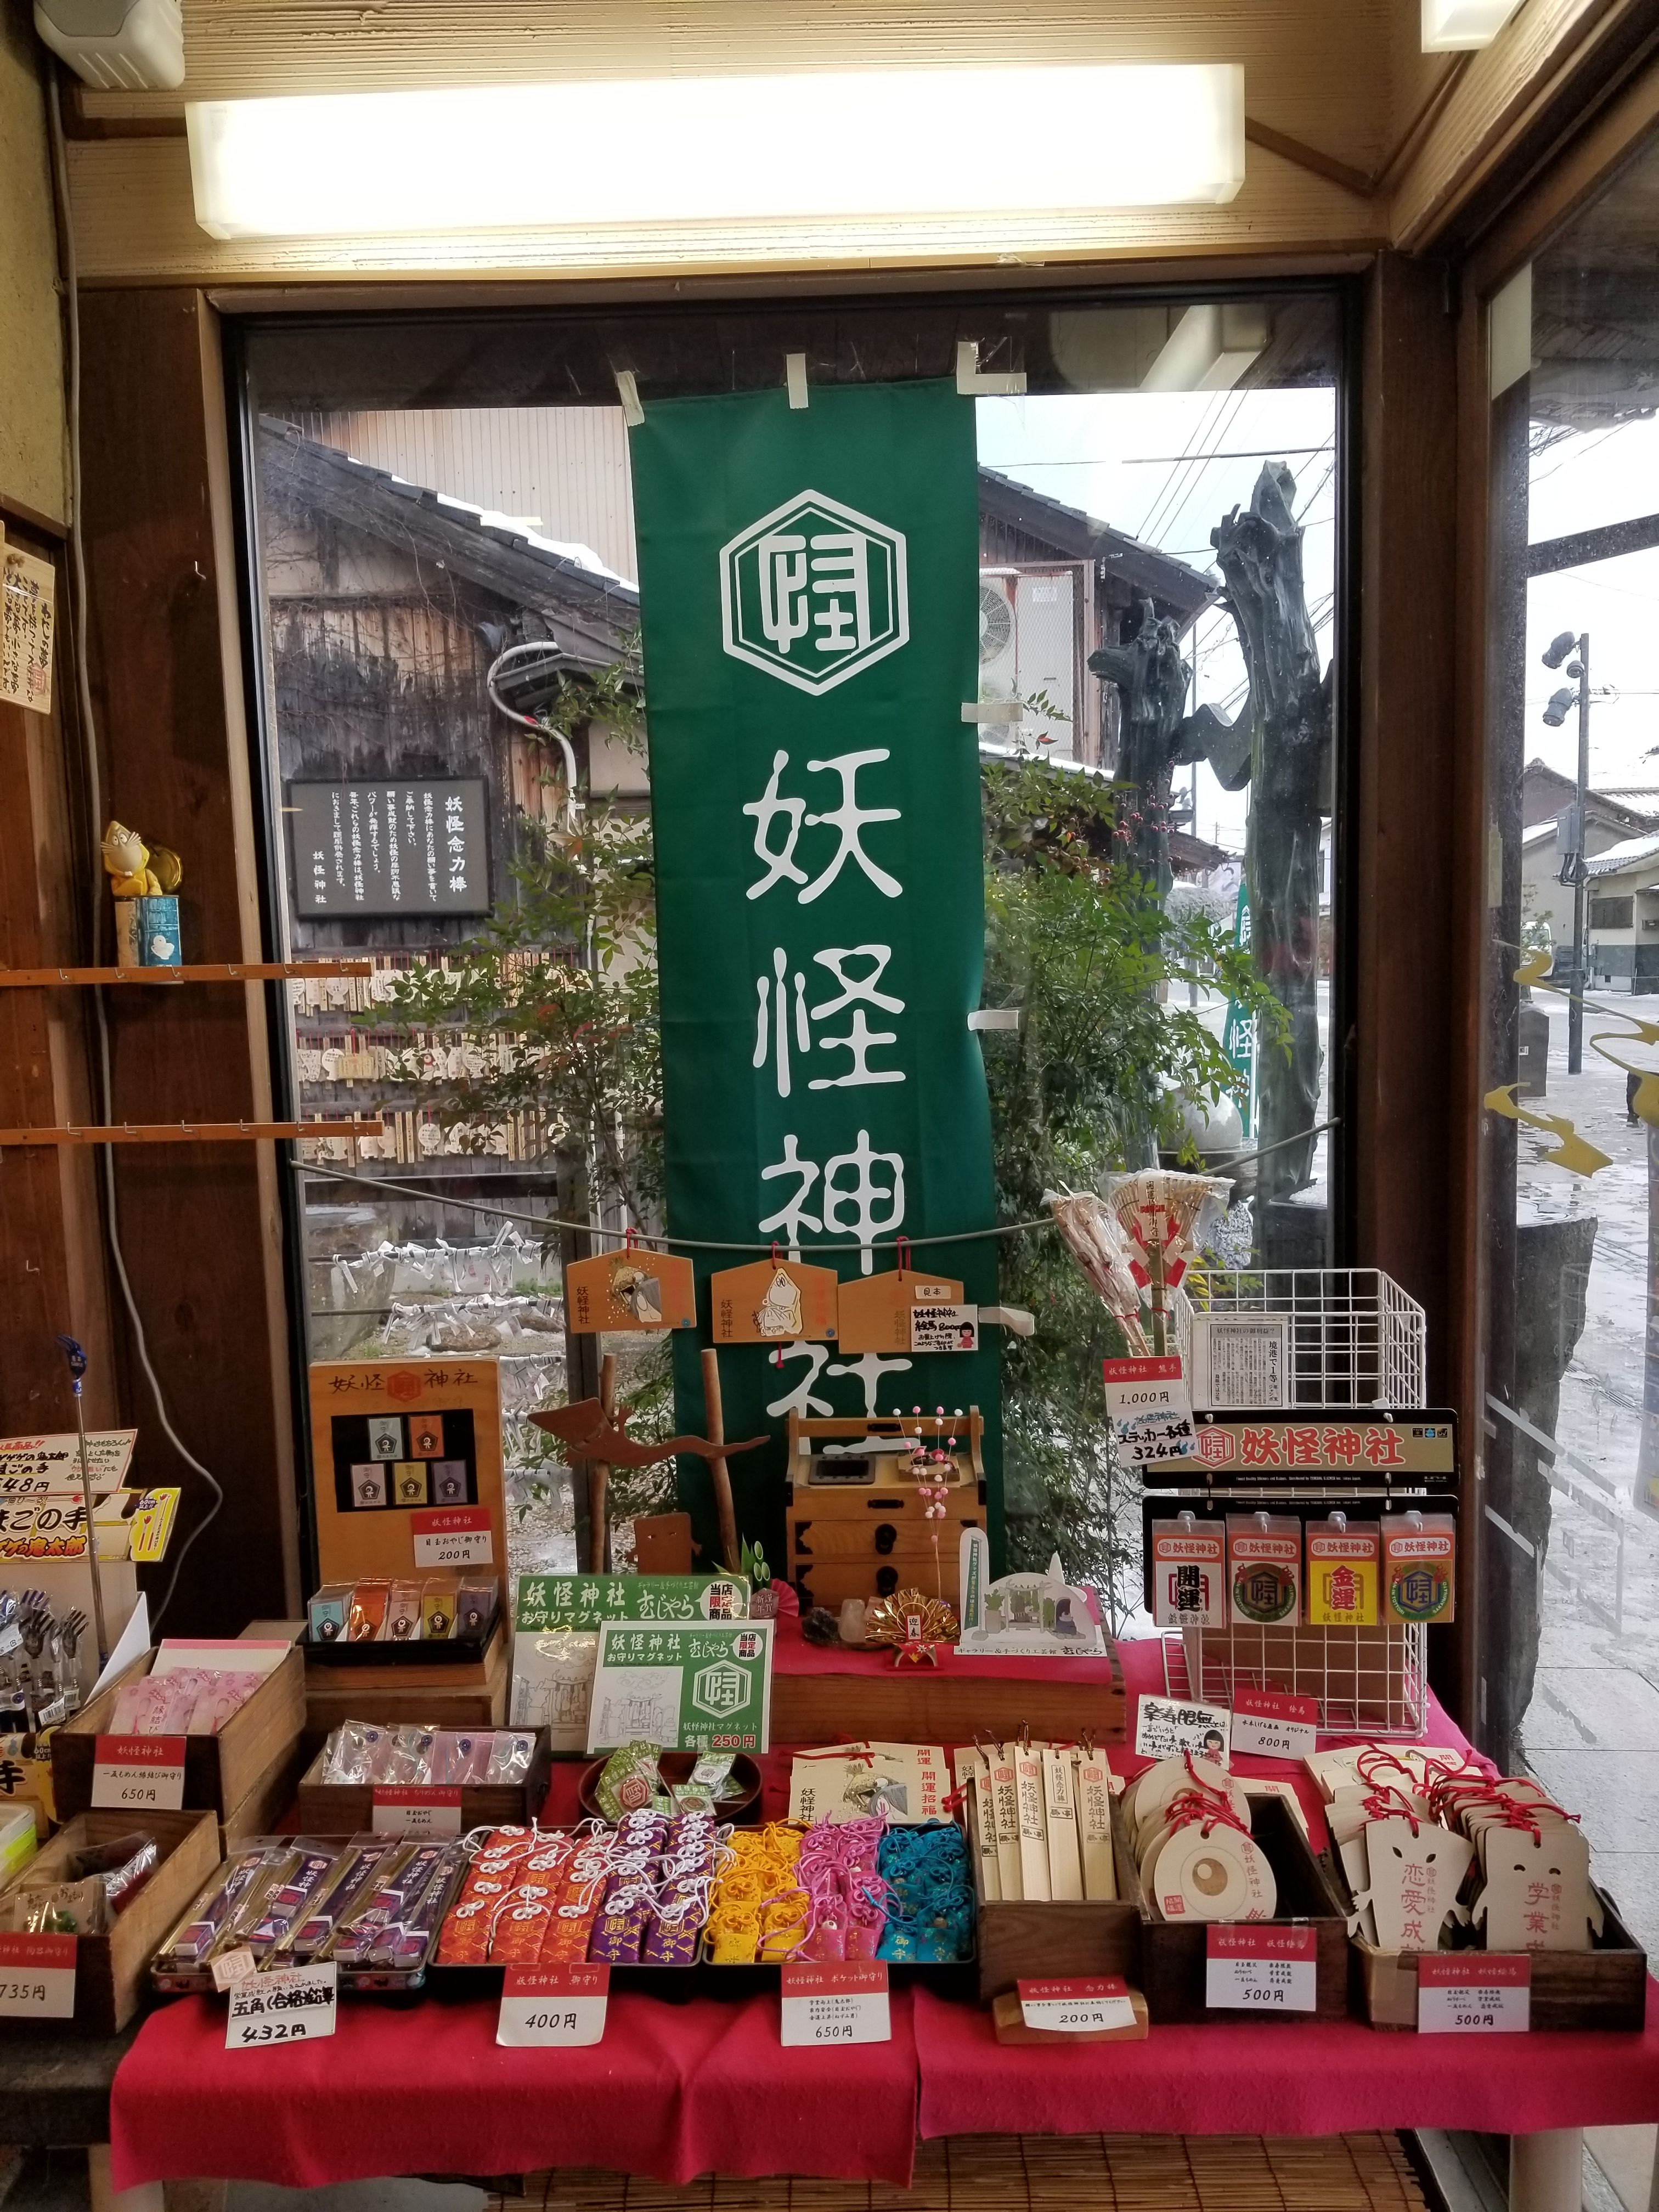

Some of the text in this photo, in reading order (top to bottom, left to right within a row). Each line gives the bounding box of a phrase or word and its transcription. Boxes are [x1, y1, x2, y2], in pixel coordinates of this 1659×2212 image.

[445, 796, 467, 893] 妖怪念力棒
[313, 851, 327, 904] 妖怪神社
[924, 1288, 940, 1296] 見本
[577, 1286, 590, 1324] 妖怪神社
[721, 1299, 733, 1338] 妖怪神社
[894, 1310, 906, 1344] 妖怪神社
[1109, 1365, 1147, 1375] 妖怪神社
[328, 1369, 478, 1394] 妖怪 神社
[1118, 1419, 1192, 1444] ステッカー各種
[1131, 1442, 1182, 1460] 324円
[1240, 1427, 1406, 1465] 妖怪神社
[0, 1477, 50, 1492] 48円
[432, 1516, 472, 1527] 妖怪神社
[438, 1550, 471, 1560] 200円
[1173, 1543, 1218, 1554] 妖怪神社
[1250, 1543, 1295, 1554] 妖怪神社
[1327, 1542, 1373, 1553] 妖怪神社
[1404, 1541, 1448, 1552] 妖怪神社
[526, 1581, 625, 1608] 妖怪神社
[710, 1584, 733, 1595] 当店
[1177, 1565, 1200, 1612] 開運
[1330, 1565, 1356, 1611] 金運
[709, 1596, 733, 1607] 限定
[521, 1610, 629, 1624] お守りマグネット
[709, 1608, 732, 1620] 商品
[1169, 1613, 1210, 1625] 妖怪神社
[1323, 1613, 1364, 1622] 妖怪神社
[908, 1617, 921, 1638] 迎春
[611, 1633, 681, 1651] 妖怪神社
[688, 1638, 729, 1658] むじゃら
[607, 1652, 682, 1662] お守りマグネット
[1246, 1699, 1305, 1716] 妖怪神社 絵馬
[149, 1705, 165, 1734] 縁結び
[683, 1722, 757, 1732] 妖怪神社マグネット
[685, 1734, 756, 1748] 各種 250円
[1258, 1737, 1290, 1750] 800円
[117, 1746, 163, 1757] 妖怪神社
[917, 1749, 932, 1765] 開運
[121, 1788, 156, 1801] 650円
[921, 1771, 936, 1815] 開運招福
[798, 1787, 816, 1821] 妖怪神社
[997, 1785, 1016, 1829] 妖怪神社
[1021, 1781, 1039, 1825] 妖怪神社
[1087, 1786, 1105, 1830] 妖怪神社
[345, 1863, 371, 1891] 妖怪神社
[402, 1860, 427, 1884] 妖怪神社
[1244, 1854, 1263, 1898] 妖怪神社
[427, 1877, 445, 1904] 妖怪神社
[1401, 1863, 1426, 1951] 恋愛成
[607, 1936, 622, 1961] 御守
[659, 1938, 676, 1962] 御守
[1218, 1938, 1256, 1946] 妖怪神社
[242, 1972, 305, 1991] 妖怪神社
[516, 1976, 597, 1986] 妖怪神社 御守り
[786, 1972, 882, 1984] 妖怪神社 ポケット御守り
[1029, 1985, 1073, 1994] 妖怪神社
[1243, 1989, 1283, 2002] 500円
[525, 2013, 577, 2030] 400円
[1059, 2013, 1104, 2023] 200円
[1455, 2015, 1493, 2025] 500円
[241, 2024, 306, 2042] 432円
[816, 2025, 853, 2038] 650円
